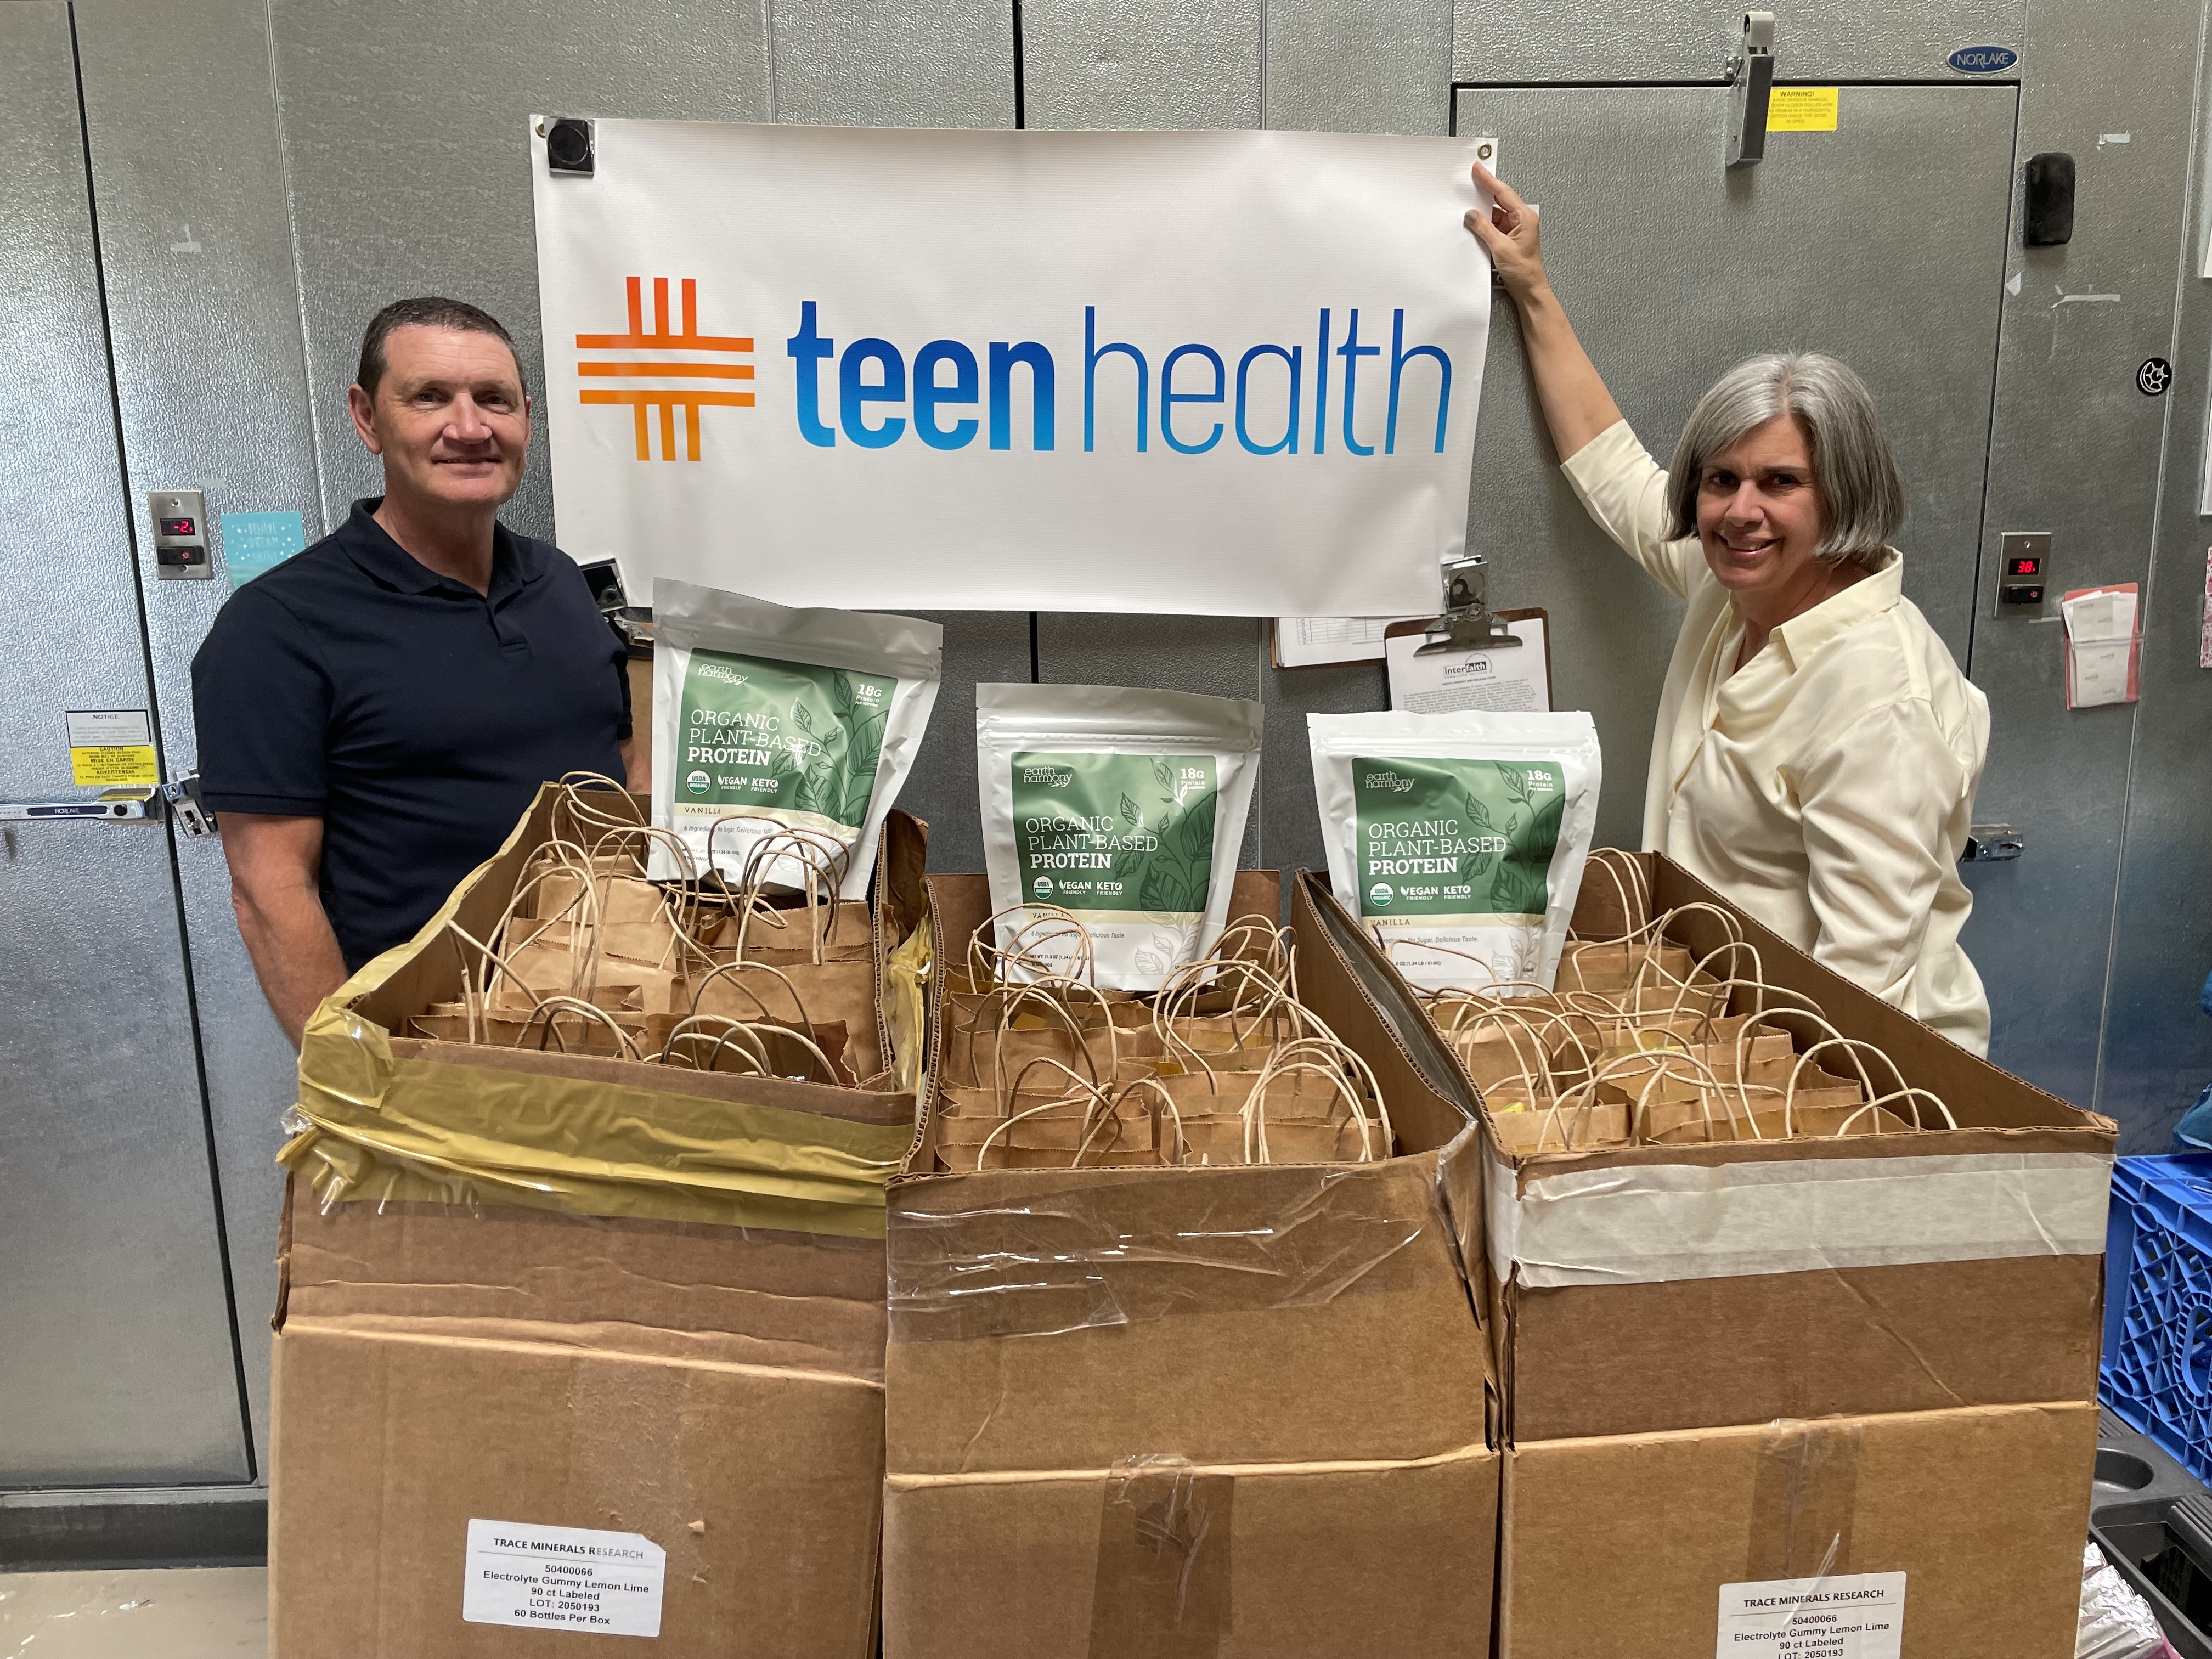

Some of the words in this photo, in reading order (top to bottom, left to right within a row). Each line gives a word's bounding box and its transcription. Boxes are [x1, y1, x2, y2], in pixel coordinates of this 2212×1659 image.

[1957, 53, 2009, 69] NORLAKE
[787, 301, 1054, 451] teen
[1084, 305, 1452, 456] health
[702, 664, 732, 674] earth
[698, 668, 748, 685] harmony
[857, 684, 882, 697] 18G
[856, 695, 879, 703] Protein
[691, 709, 780, 731] ORGANIC
[689, 727, 821, 757] PLANT-BASED
[687, 747, 772, 766] PROTEIN
[1025, 766, 1055, 775] earth
[1180, 768, 1204, 779] 18G
[1367, 771, 1397, 781] earth
[1526, 770, 1552, 781] 18G
[718, 775, 747, 786] VEGAN
[752, 778, 779, 788] KETO
[1023, 774, 1073, 787] harmony
[1365, 778, 1415, 792] harmony
[1025, 816, 1113, 833] ORGANIC
[1369, 819, 1458, 839] ORGANIC
[1028, 834, 1158, 851] PLANT-BASED
[1369, 837, 1506, 857] PLANT-BASED
[1030, 853, 1112, 868] PROTEIN
[1369, 857, 1458, 876] PROTEIN
[1059, 880, 1091, 890] VEGAN
[1097, 882, 1123, 891] KETO
[1400, 886, 1438, 896] VEGAN
[1443, 885, 1471, 894] KETO
[494, 1538, 527, 1549] TRACE
[531, 1542, 585, 1554] MINERALS
[589, 1547, 644, 1559] RESEARCH
[545, 1565, 592, 1576] 50400066
[483, 1571, 538, 1584] Electrolyte
[542, 1577, 582, 1589] Gummy
[585, 1580, 620, 1591] Lemon
[624, 1583, 649, 1593] Lime
[531, 1587, 543, 1595] 90
[559, 1590, 600, 1601] Labeled
[1743, 1598, 1776, 1607] TRACE
[1779, 1593, 1830, 1605] MINERALS
[1833, 1590, 1884, 1601] RESEARCH
[529, 1599, 555, 1609] LOT:
[558, 1601, 600, 1612] 2050193
[514, 1609, 526, 1618] 60
[529, 1610, 566, 1621] Bottles
[569, 1613, 587, 1623] Per
[590, 1616, 610, 1625] Box
[1792, 1615, 1837, 1625] 50400066
[1734, 1630, 1786, 1641] Electrolyte
[1789, 1627, 1826, 1638] Gummy
[1830, 1624, 1863, 1634] Lemon
[1865, 1622, 1889, 1632] Lime
[1779, 1641, 1791, 1650] 90
[1793, 1640, 1803, 1649] ct
[1805, 1637, 1843, 1647] Labeled
[1805, 1649, 1843, 1659] 2050193
